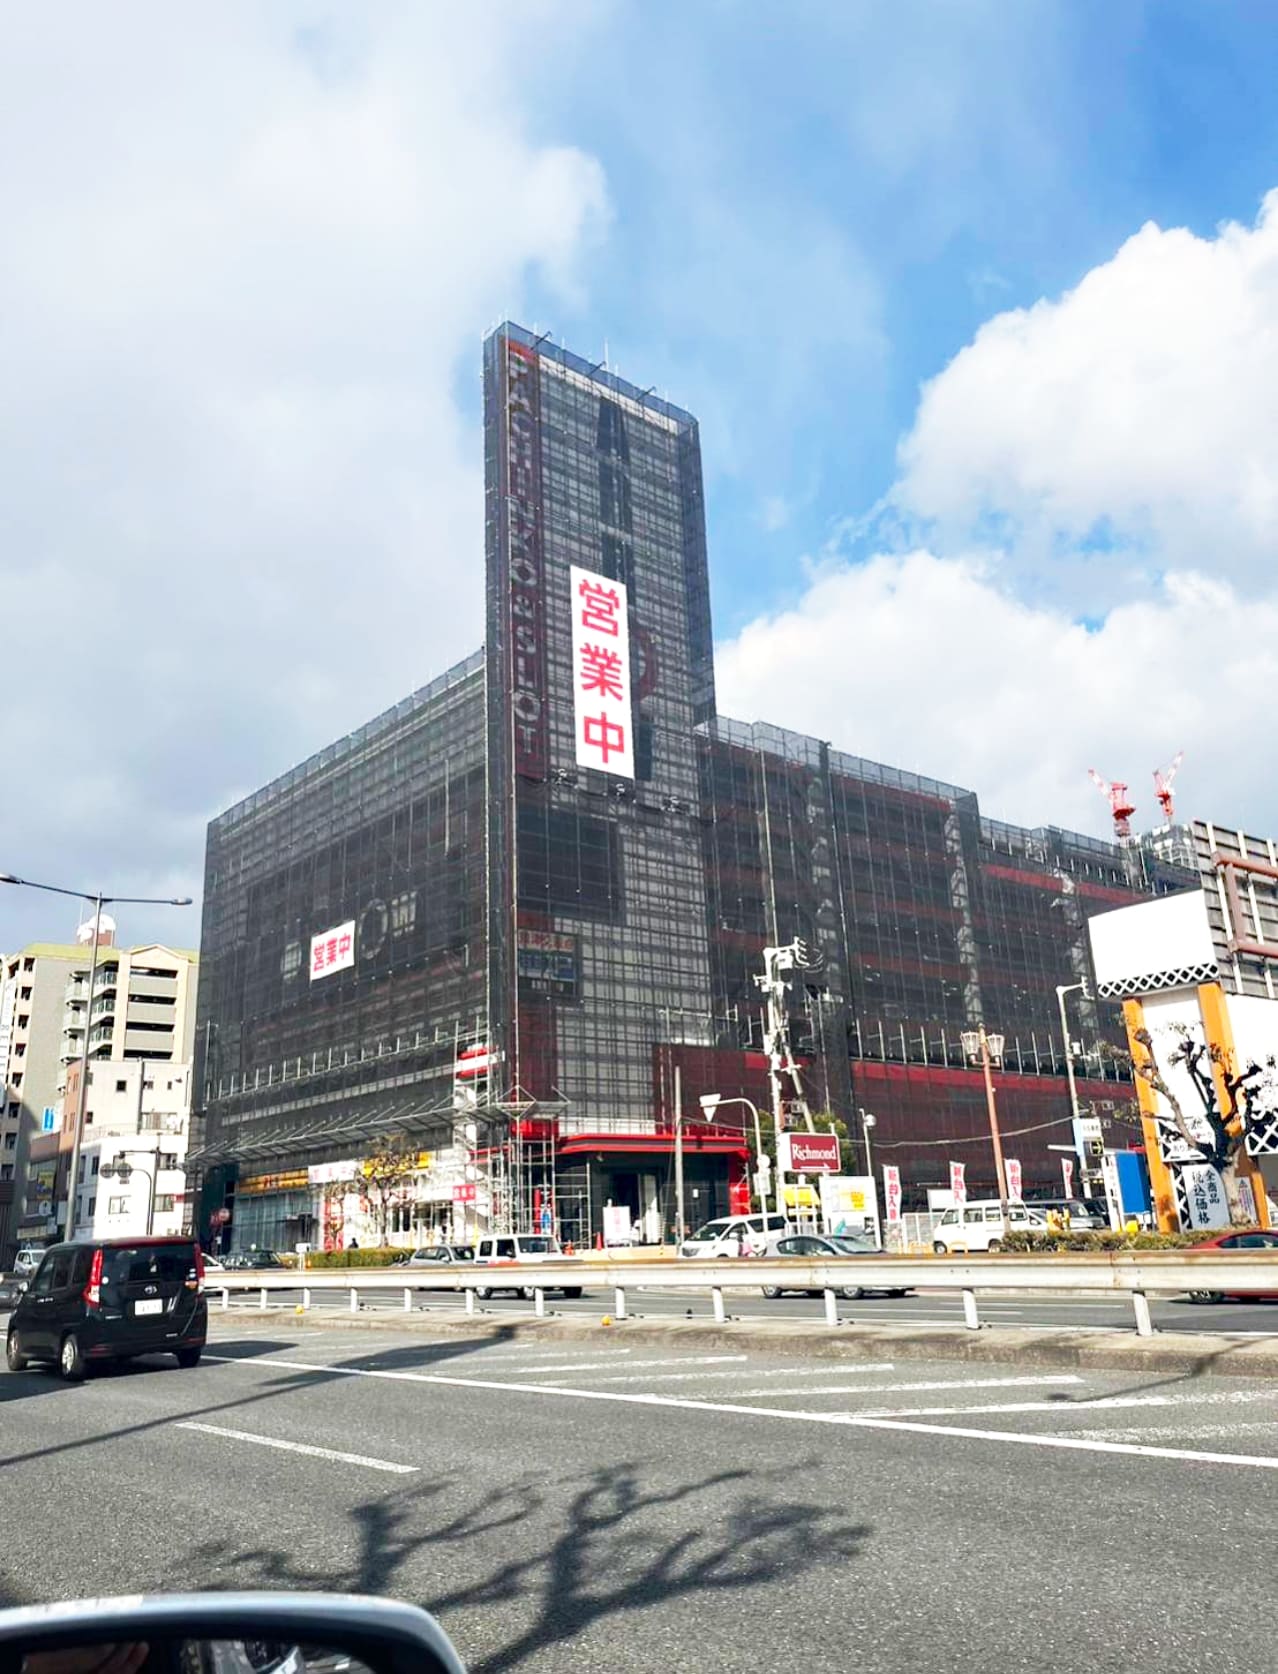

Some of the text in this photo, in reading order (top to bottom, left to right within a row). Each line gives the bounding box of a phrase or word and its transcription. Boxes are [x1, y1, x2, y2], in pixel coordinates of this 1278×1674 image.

[514, 625, 541, 754] SLOT
[579, 578, 625, 764] 営業中
[313, 933, 352, 972] 営業中
[791, 1143, 836, 1161] Richmond
[1192, 1170, 1211, 1225] 税込価格
[1205, 1170, 1220, 1204] 全商品
